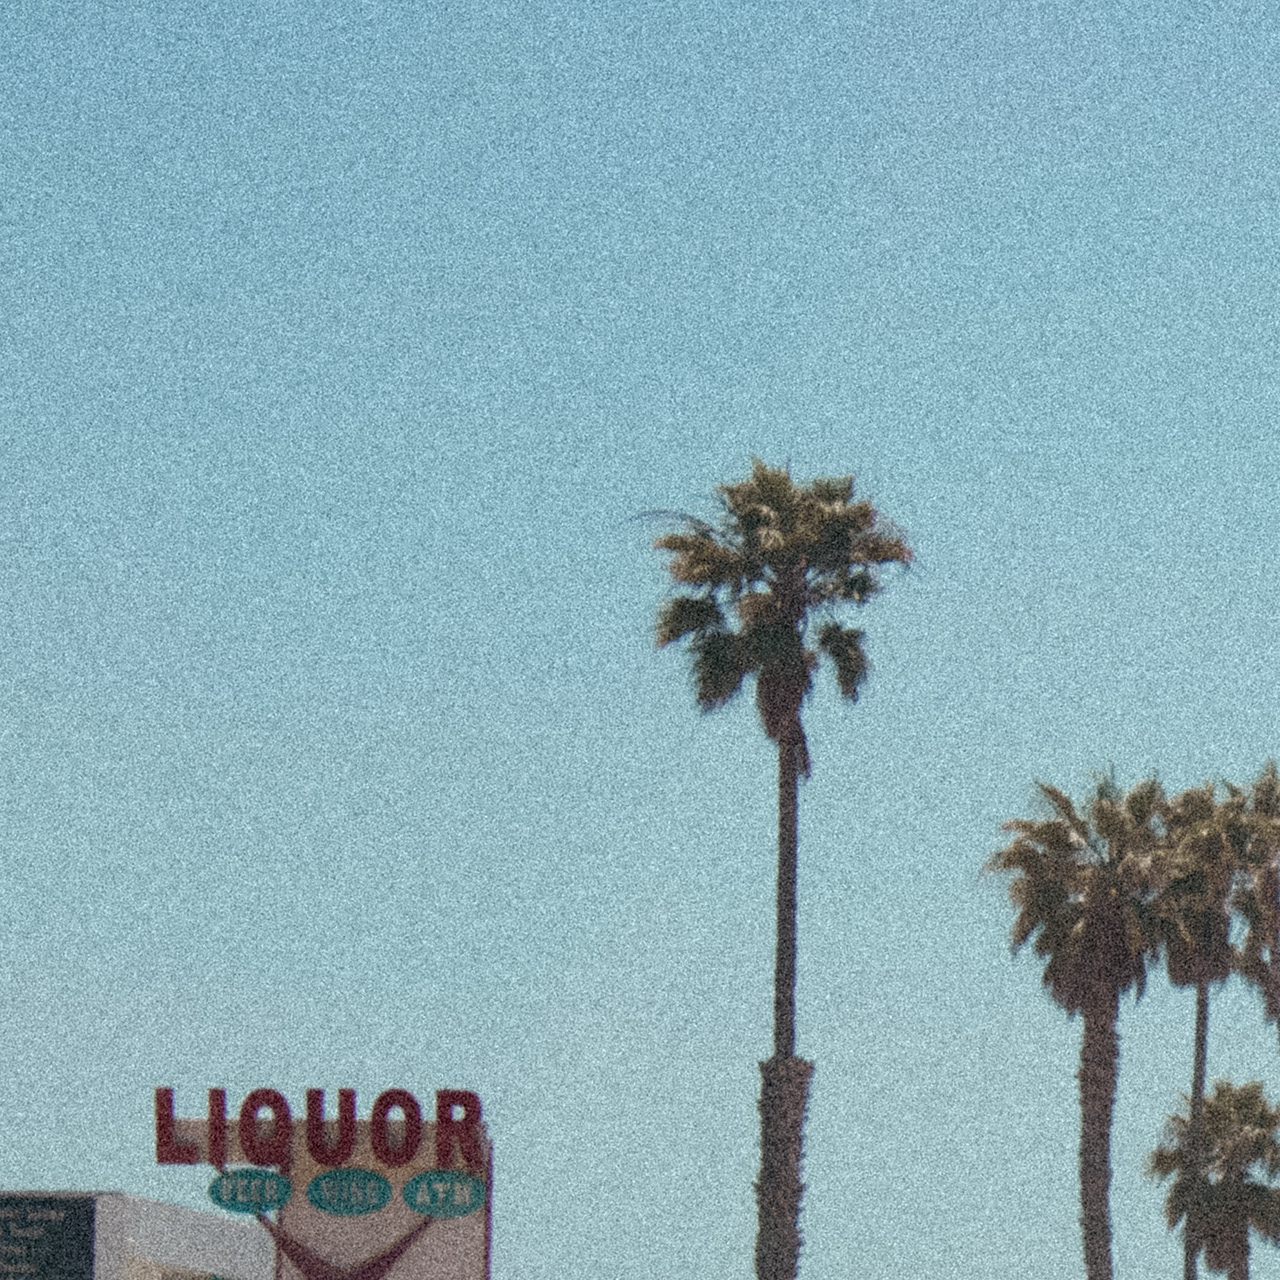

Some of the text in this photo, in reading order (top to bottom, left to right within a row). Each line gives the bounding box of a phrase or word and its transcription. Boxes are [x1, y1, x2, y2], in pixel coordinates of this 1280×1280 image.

[155, 1088, 482, 1170] LIQUOR
[219, 1178, 278, 1201] BEER
[415, 1182, 473, 1206] ATM
